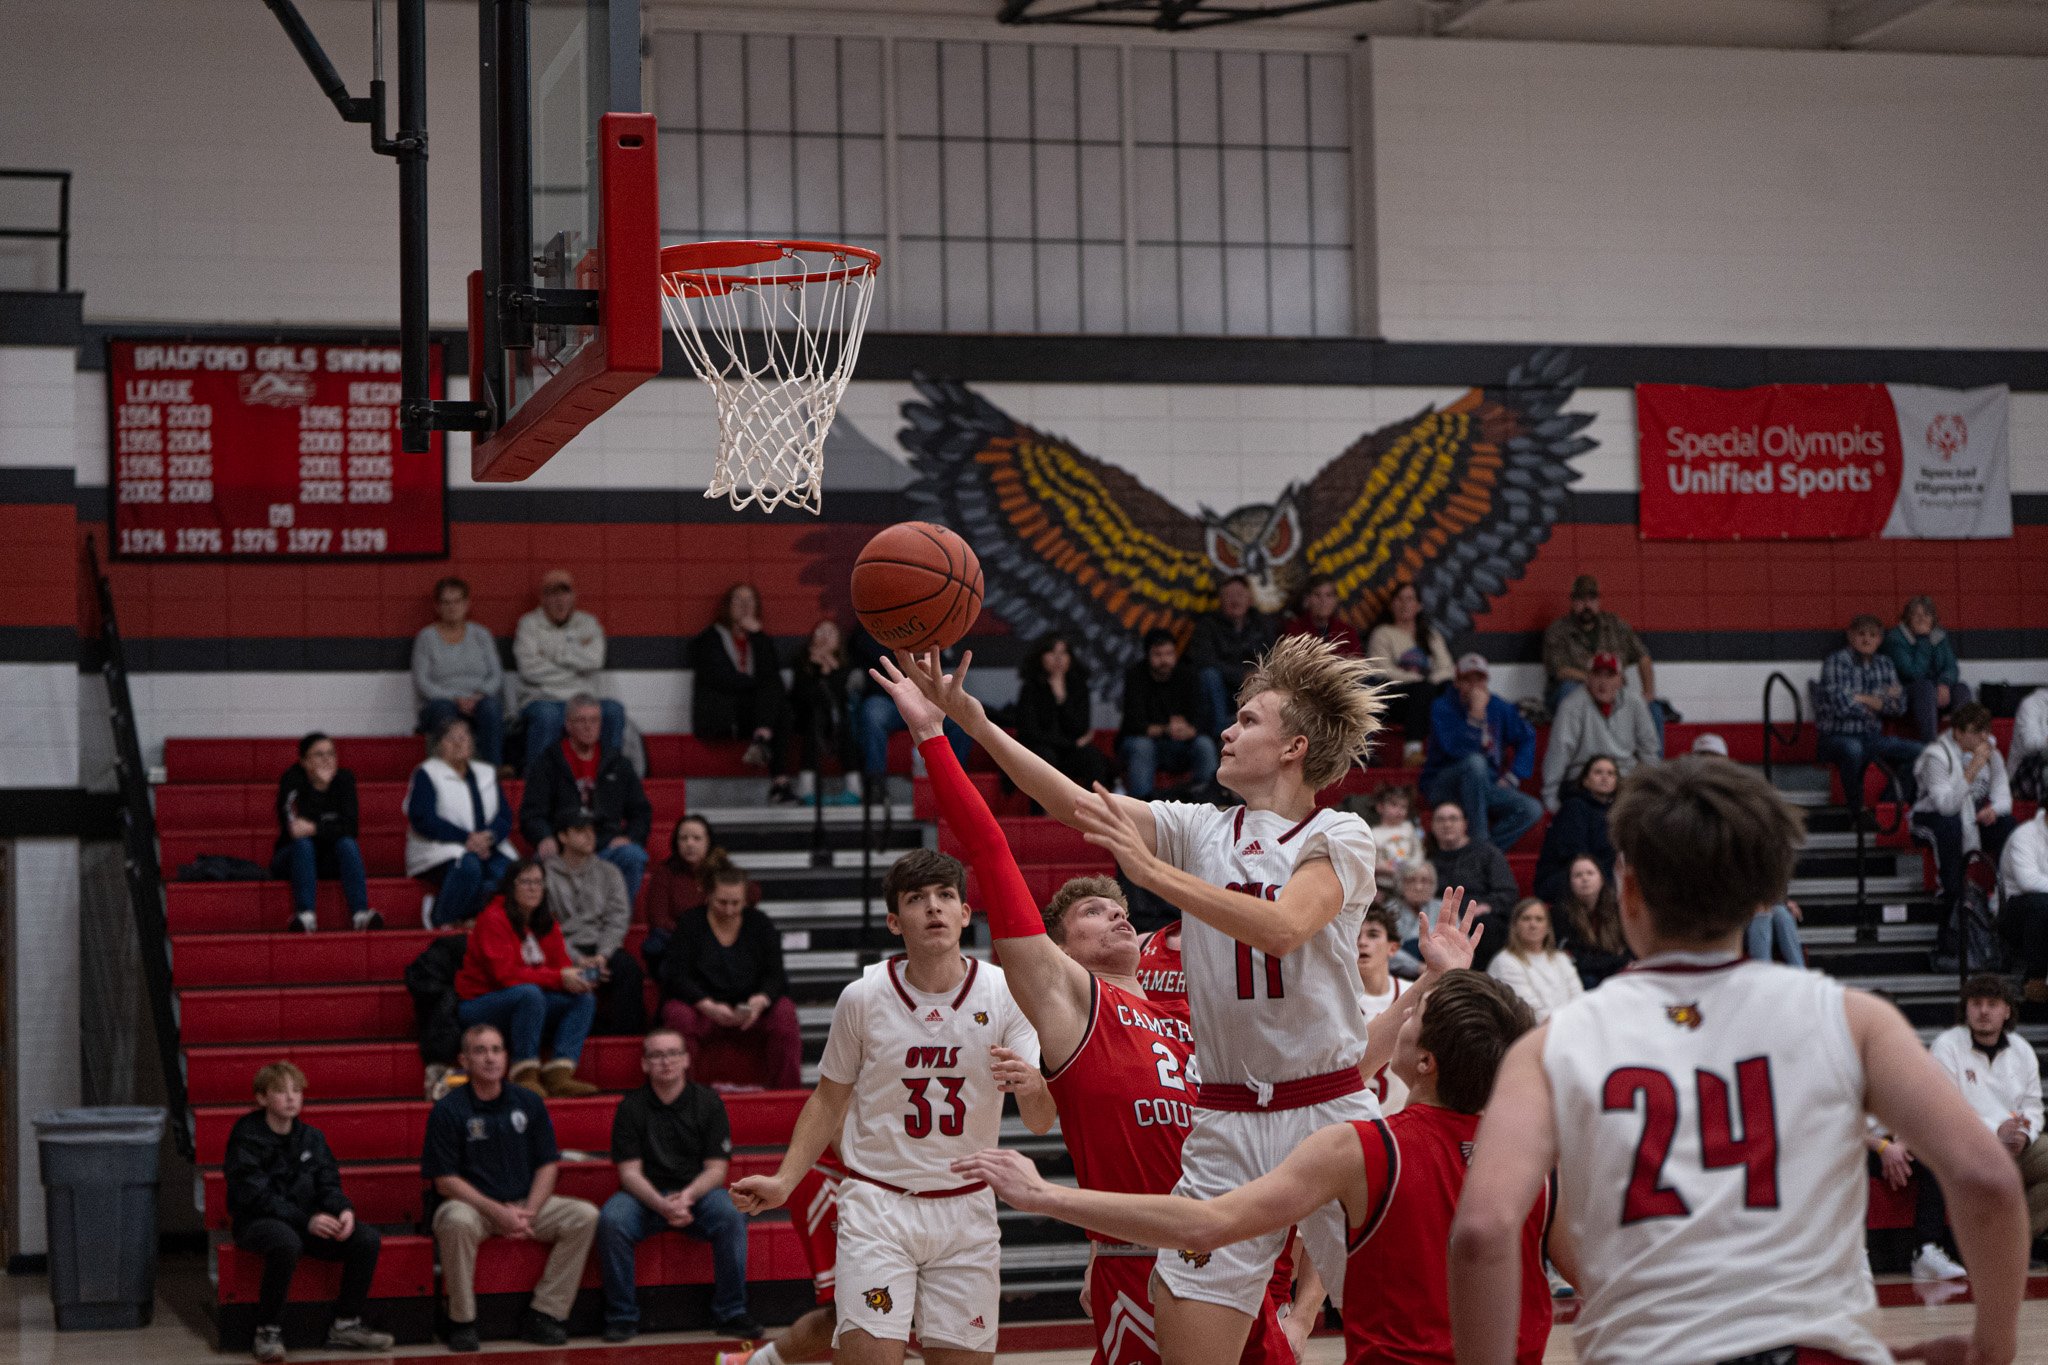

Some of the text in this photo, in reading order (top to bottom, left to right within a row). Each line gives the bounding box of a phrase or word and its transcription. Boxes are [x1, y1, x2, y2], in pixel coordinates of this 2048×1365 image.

[134, 347, 248, 371] BRADFORD
[255, 348, 318, 372] GIRLS
[1666, 424, 1885, 463] Special Olympics
[1667, 461, 1774, 495] Unified
[120, 528, 166, 553] 1974
[287, 528, 333, 553] 1977
[905, 1046, 963, 1069] OWLS
[901, 1076, 967, 1139] 33
[1133, 1098, 1196, 1128] COU
[1602, 1055, 1781, 1228] 24
